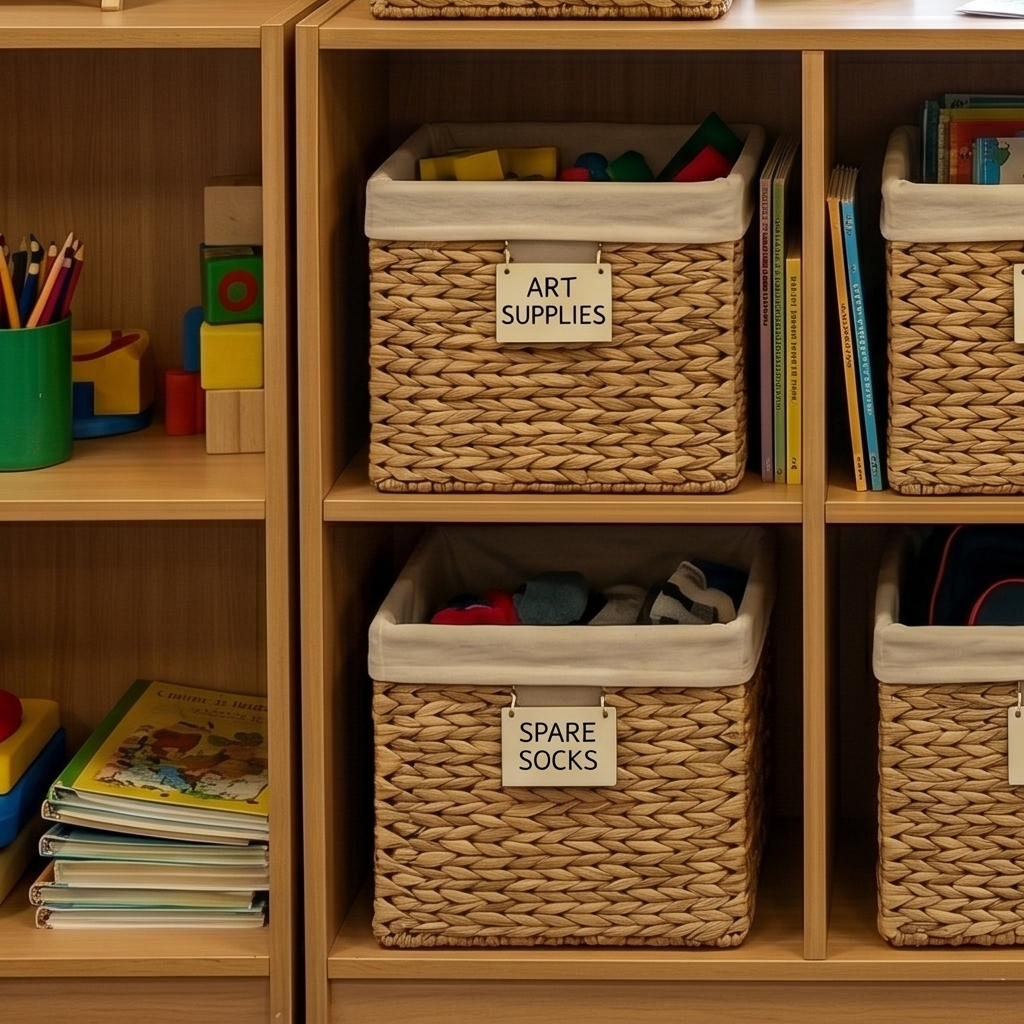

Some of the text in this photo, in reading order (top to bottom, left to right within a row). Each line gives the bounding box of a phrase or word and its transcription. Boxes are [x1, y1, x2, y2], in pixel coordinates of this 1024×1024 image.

[526, 276, 577, 298] ART
[501, 304, 606, 325] SUPPLIES
[519, 721, 596, 743] SPARE
[518, 749, 598, 771] SOCKS
